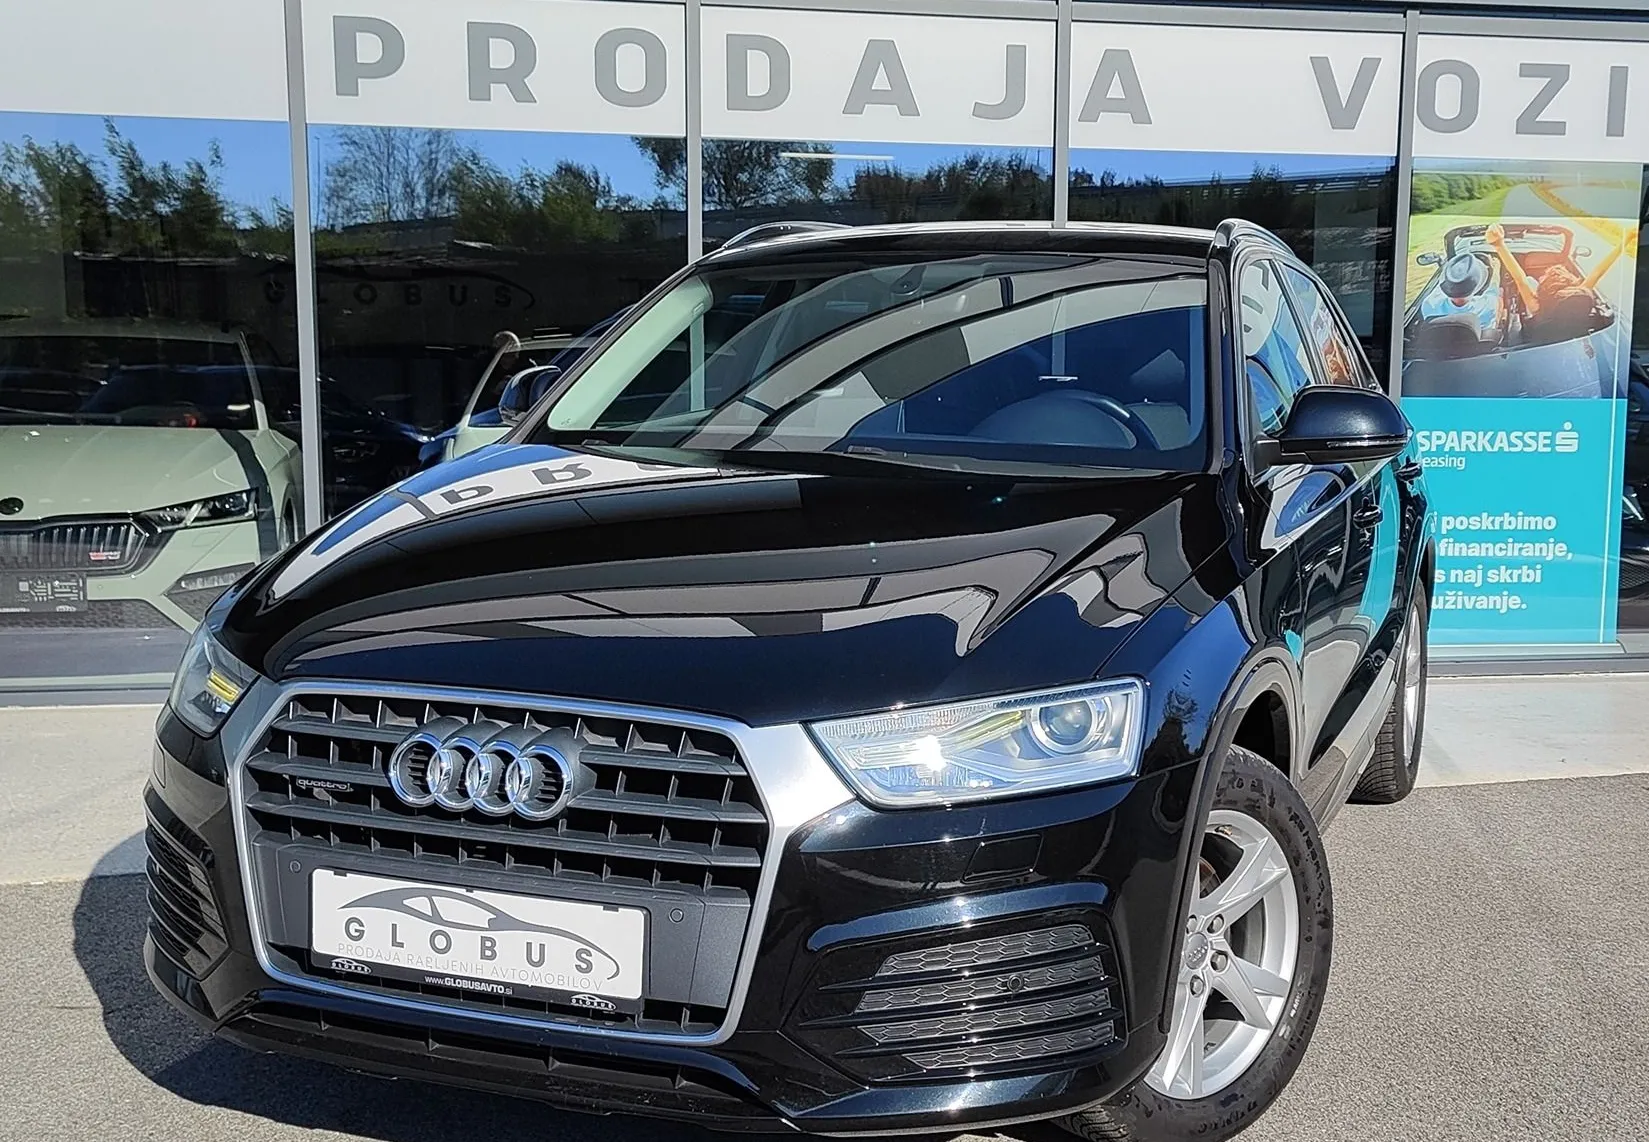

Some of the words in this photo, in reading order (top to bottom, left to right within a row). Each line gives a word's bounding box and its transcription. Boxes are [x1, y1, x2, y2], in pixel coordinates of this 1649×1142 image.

[333, 15, 1152, 125] PRODAJA
[1310, 56, 1629, 137] VOZI
[264, 280, 512, 307] GOBUS
[1416, 430, 1551, 452] SPARKASSE
[1421, 454, 1465, 470] easing
[1441, 511, 1557, 534] poskrbimo
[1439, 538, 1573, 560] financiranje,
[1450, 565, 1483, 587] naj
[1487, 564, 1542, 583] skrbi
[1431, 591, 1527, 613] uživanje.
[298, 779, 348, 790] quattro
[344, 916, 594, 974] GLOBUS
[338, 943, 401, 963] PRODAJA
[490, 965, 604, 991] AVTOMOBILOV
[424, 975, 513, 995] www.GLOBUSAVTO.si
